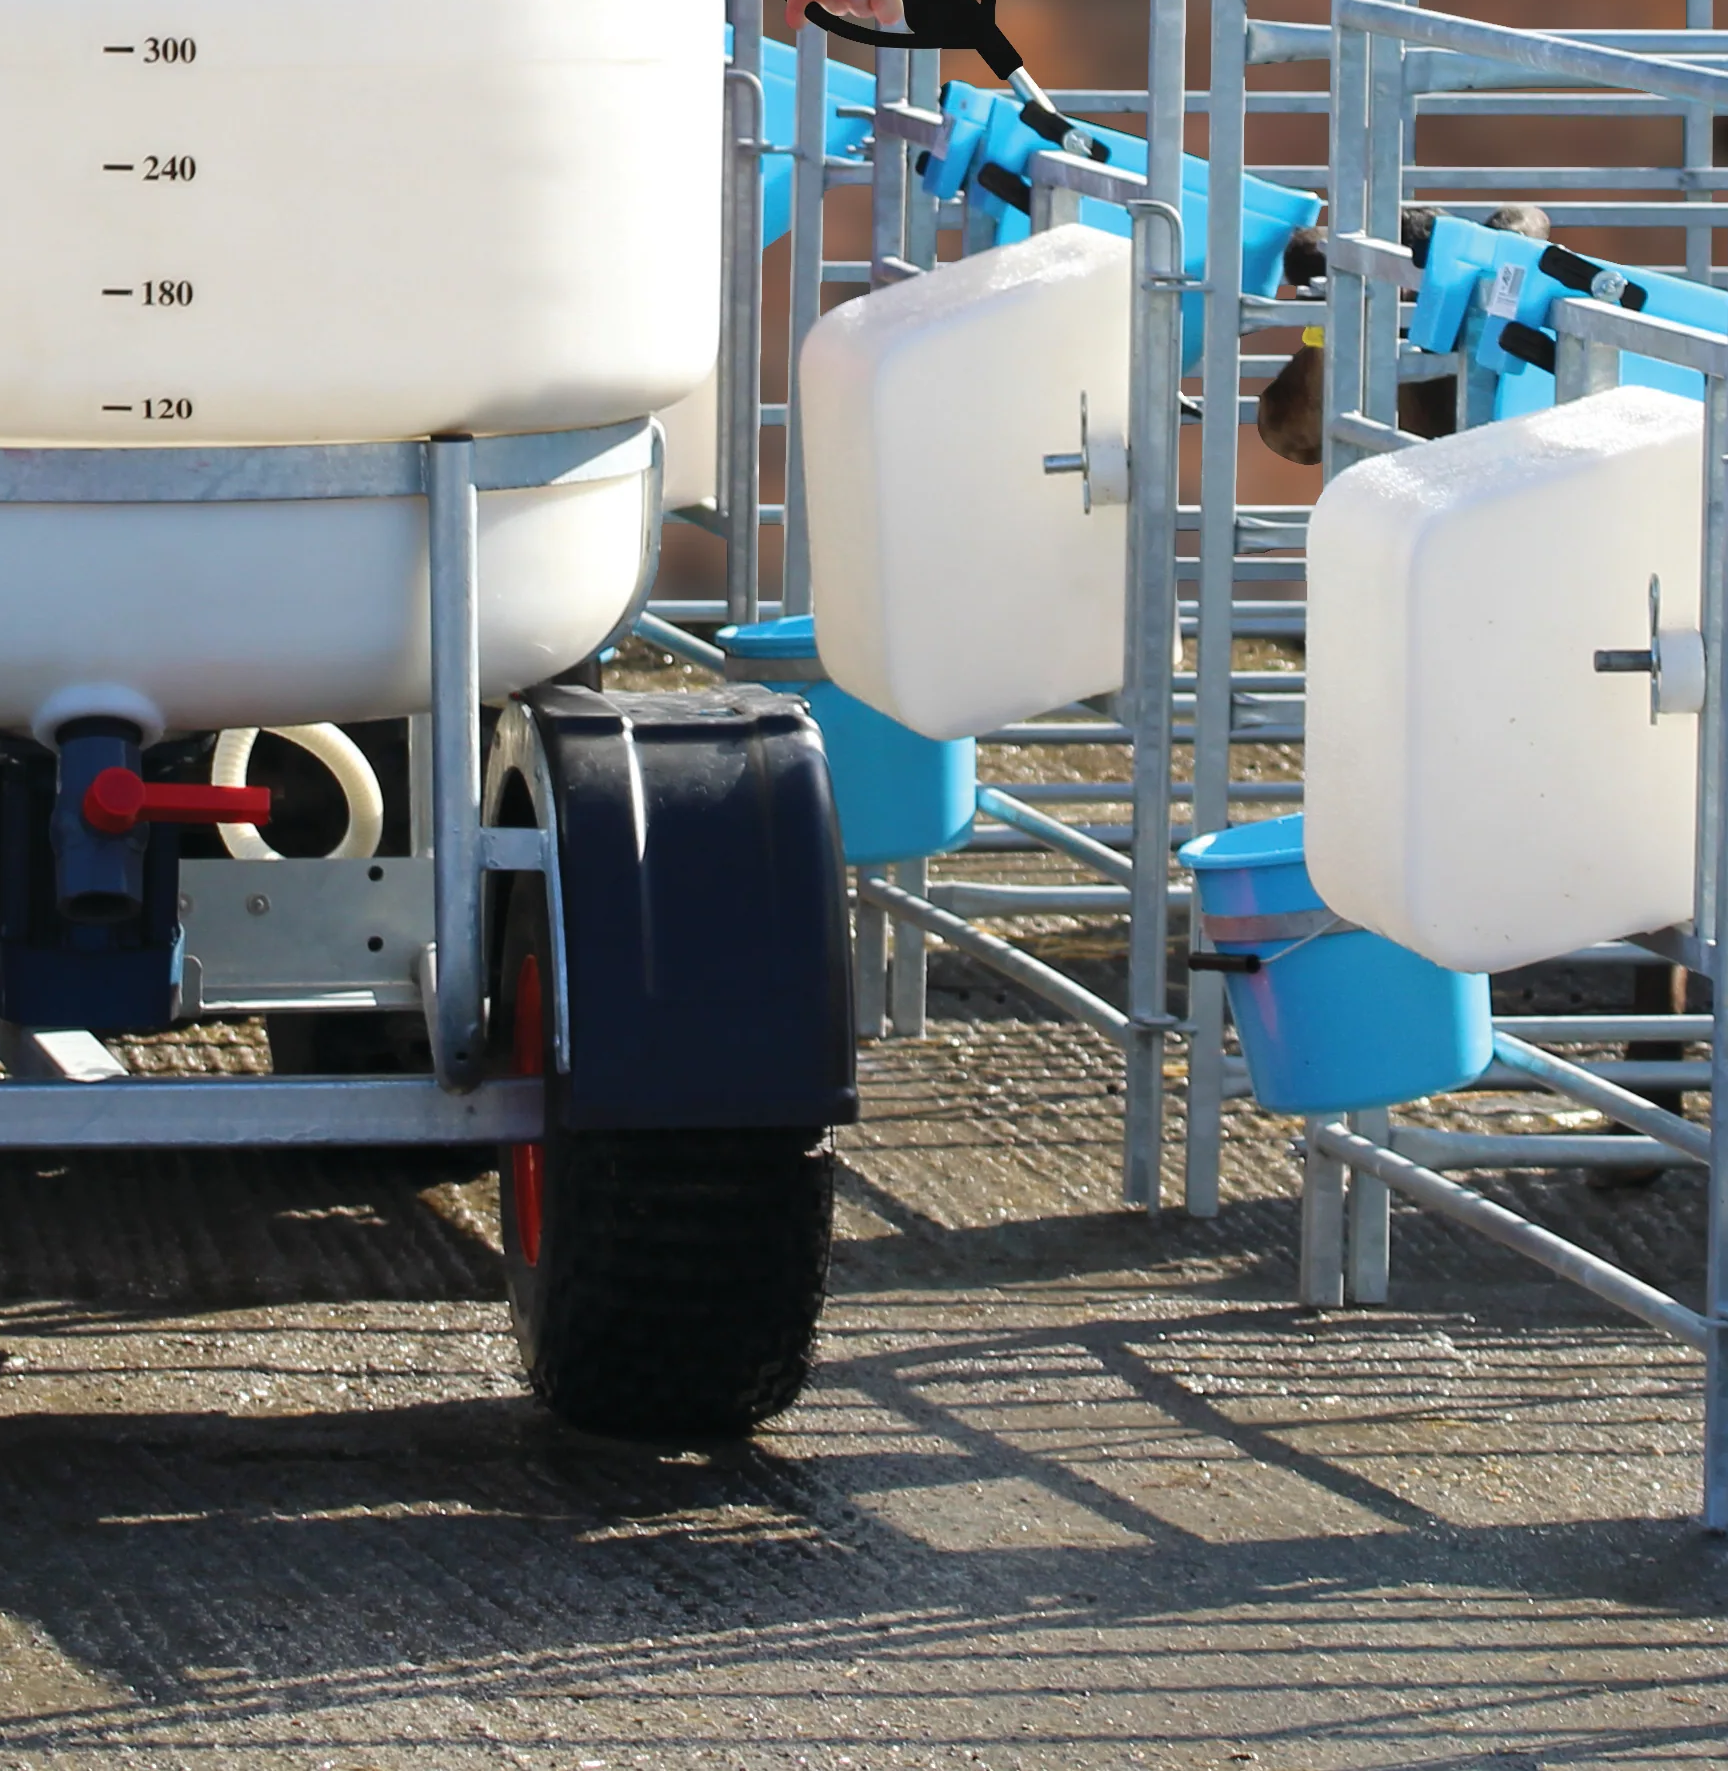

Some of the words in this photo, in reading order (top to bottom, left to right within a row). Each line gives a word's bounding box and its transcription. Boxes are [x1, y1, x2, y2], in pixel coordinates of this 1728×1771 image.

[143, 37, 197, 63] 300
[143, 155, 196, 181] 240
[144, 280, 194, 306] 180
[144, 398, 193, 420] 120
